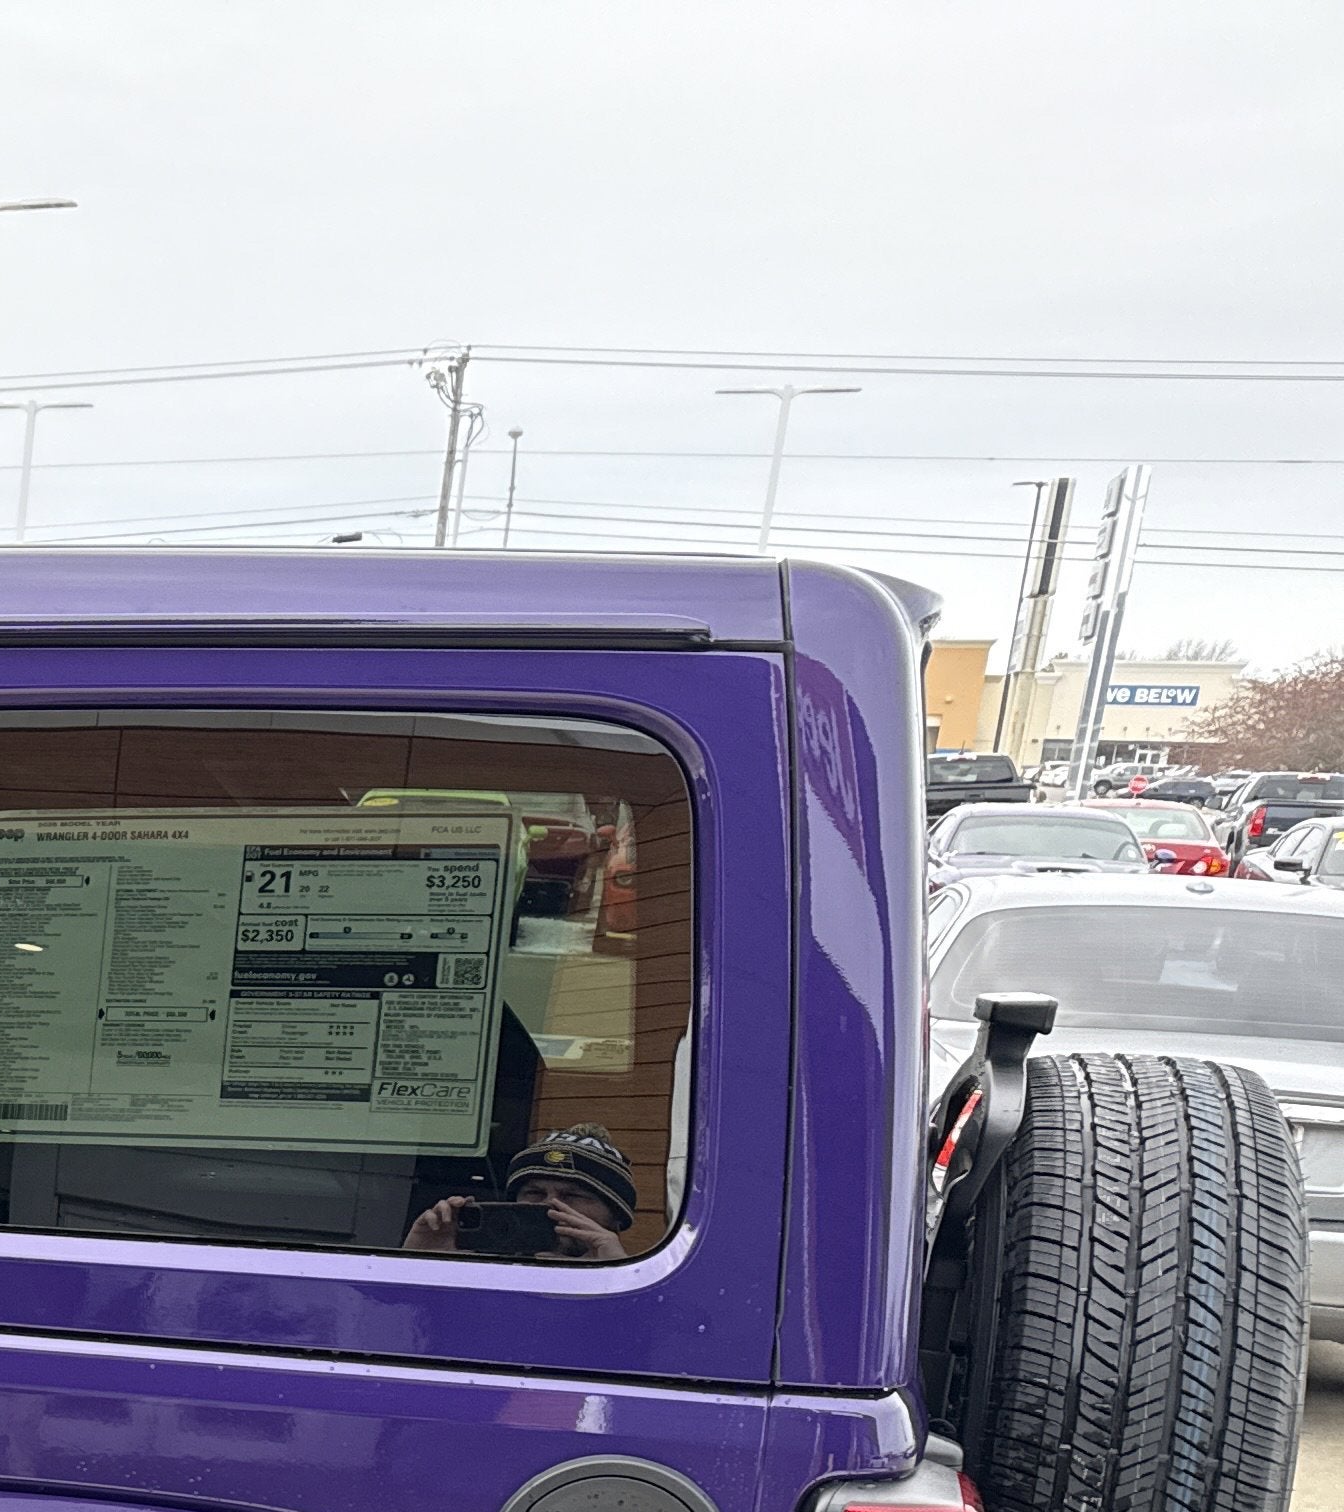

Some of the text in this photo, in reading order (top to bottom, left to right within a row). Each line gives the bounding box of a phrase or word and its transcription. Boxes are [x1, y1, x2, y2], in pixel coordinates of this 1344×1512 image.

[36, 829, 190, 842] WRANGLER 4-DOOR SAHARA 4X4
[431, 826, 482, 834] FCA US LLC
[264, 848, 394, 857] Fuel Economy and Environment
[299, 869, 319, 877] MPG
[443, 862, 481, 874] spend
[257, 869, 293, 894] 21
[425, 874, 482, 890] $3,250
[274, 918, 300, 927] cost
[240, 928, 295, 945] $2,350
[377, 1081, 472, 1099] FlexCare
[414, 1100, 470, 1108] PROTECTION
